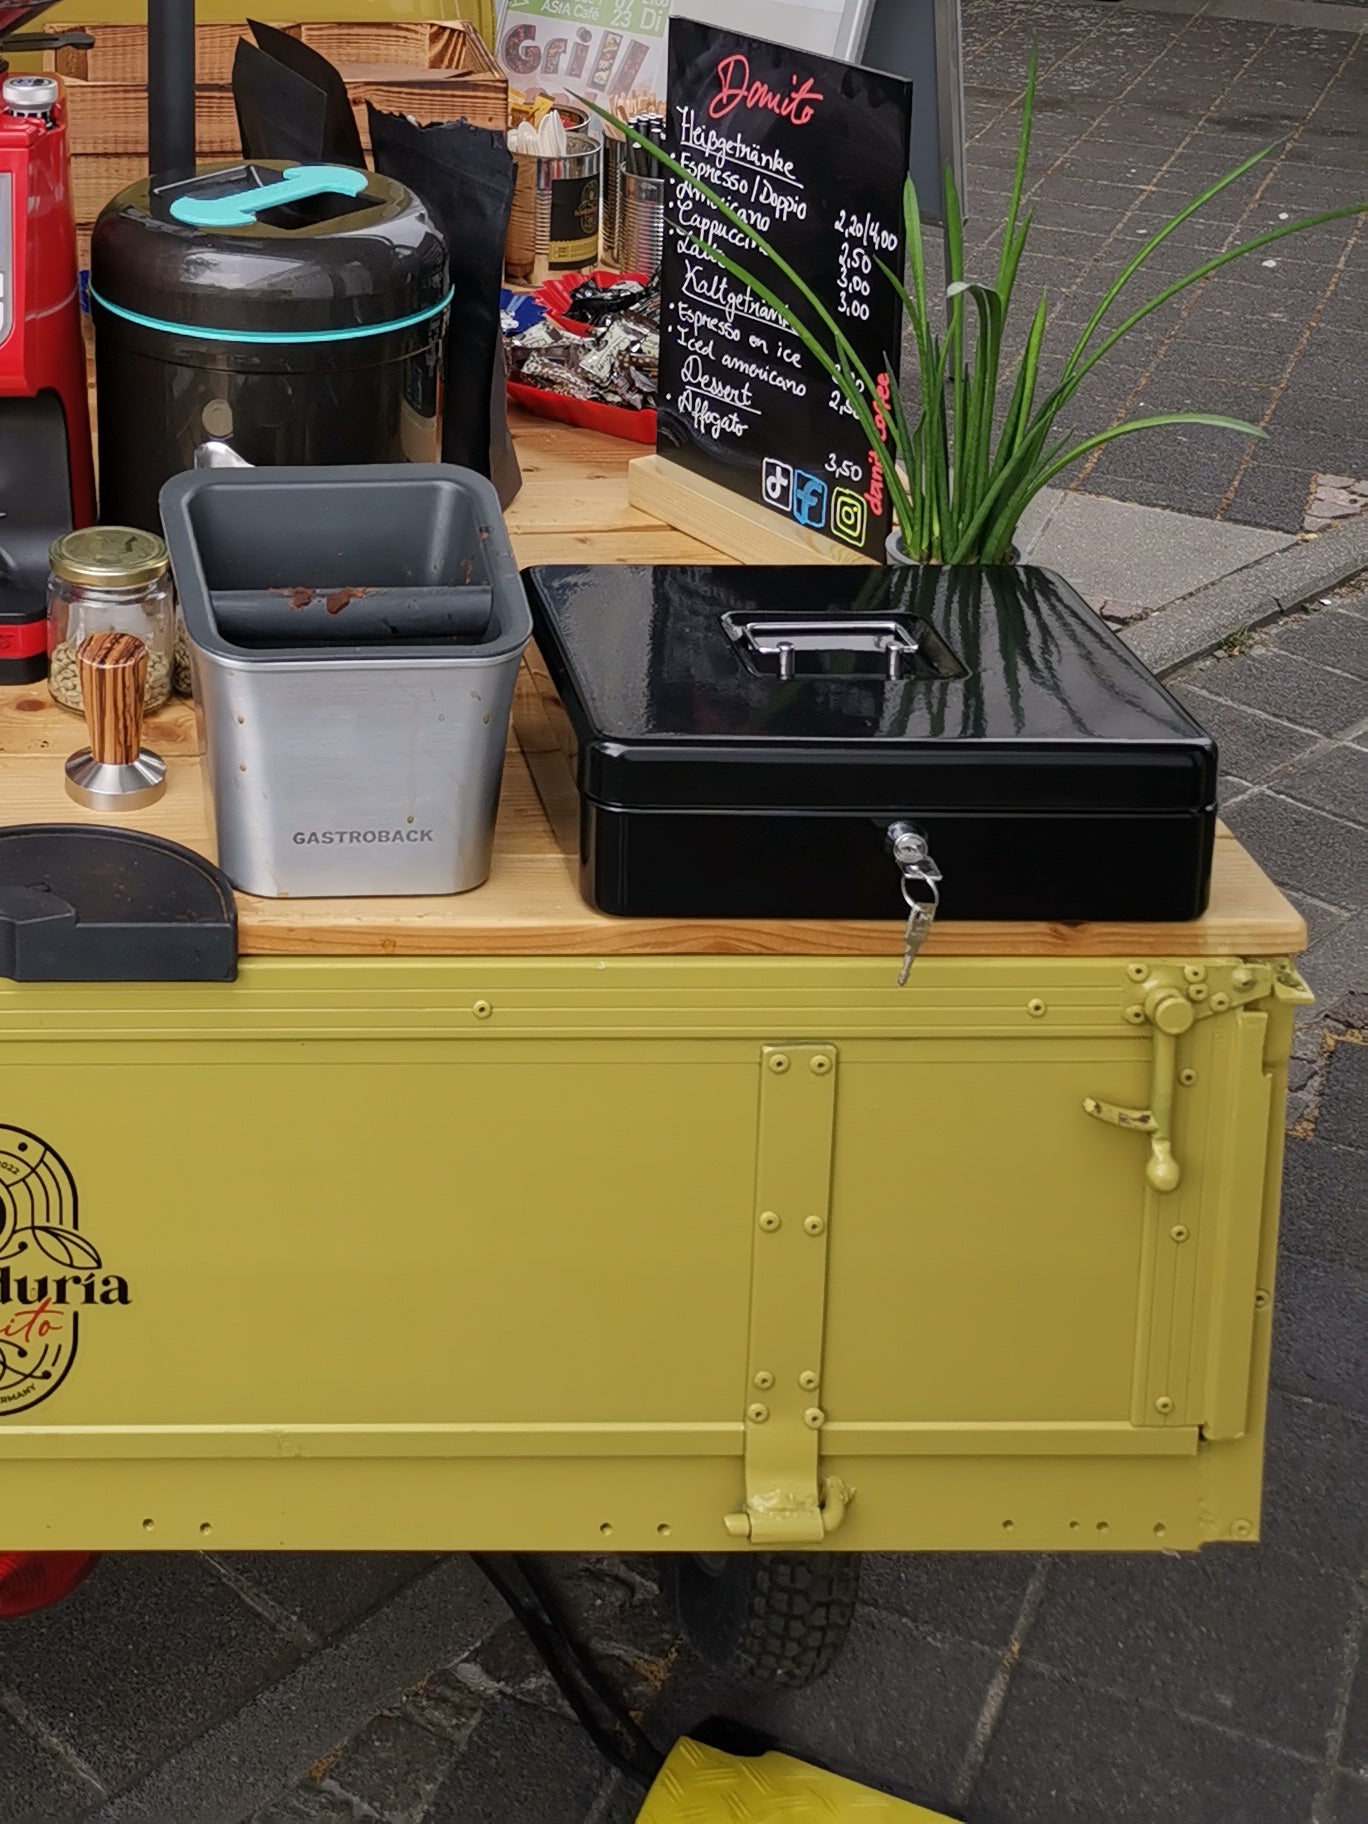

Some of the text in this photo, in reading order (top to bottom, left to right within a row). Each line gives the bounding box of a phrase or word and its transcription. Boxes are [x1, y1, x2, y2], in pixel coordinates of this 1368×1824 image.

[574, 5, 600, 21] Café
[611, 9, 632, 28] 23
[639, 8, 663, 32] Di
[501, 23, 650, 95] Grill
[676, 106, 796, 179] Heißgetränke
[838, 241, 872, 274] 2,50
[837, 265, 870, 296] 3,00
[837, 290, 870, 320] 3,00
[678, 301, 740, 342] Espresso
[777, 341, 802, 368] ice
[677, 325, 716, 360] Iced
[722, 354, 806, 396] americano
[681, 354, 753, 406] Dessert
[678, 389, 862, 481] Affogato 3,50
[292, 829, 434, 845] GASTROBACK
